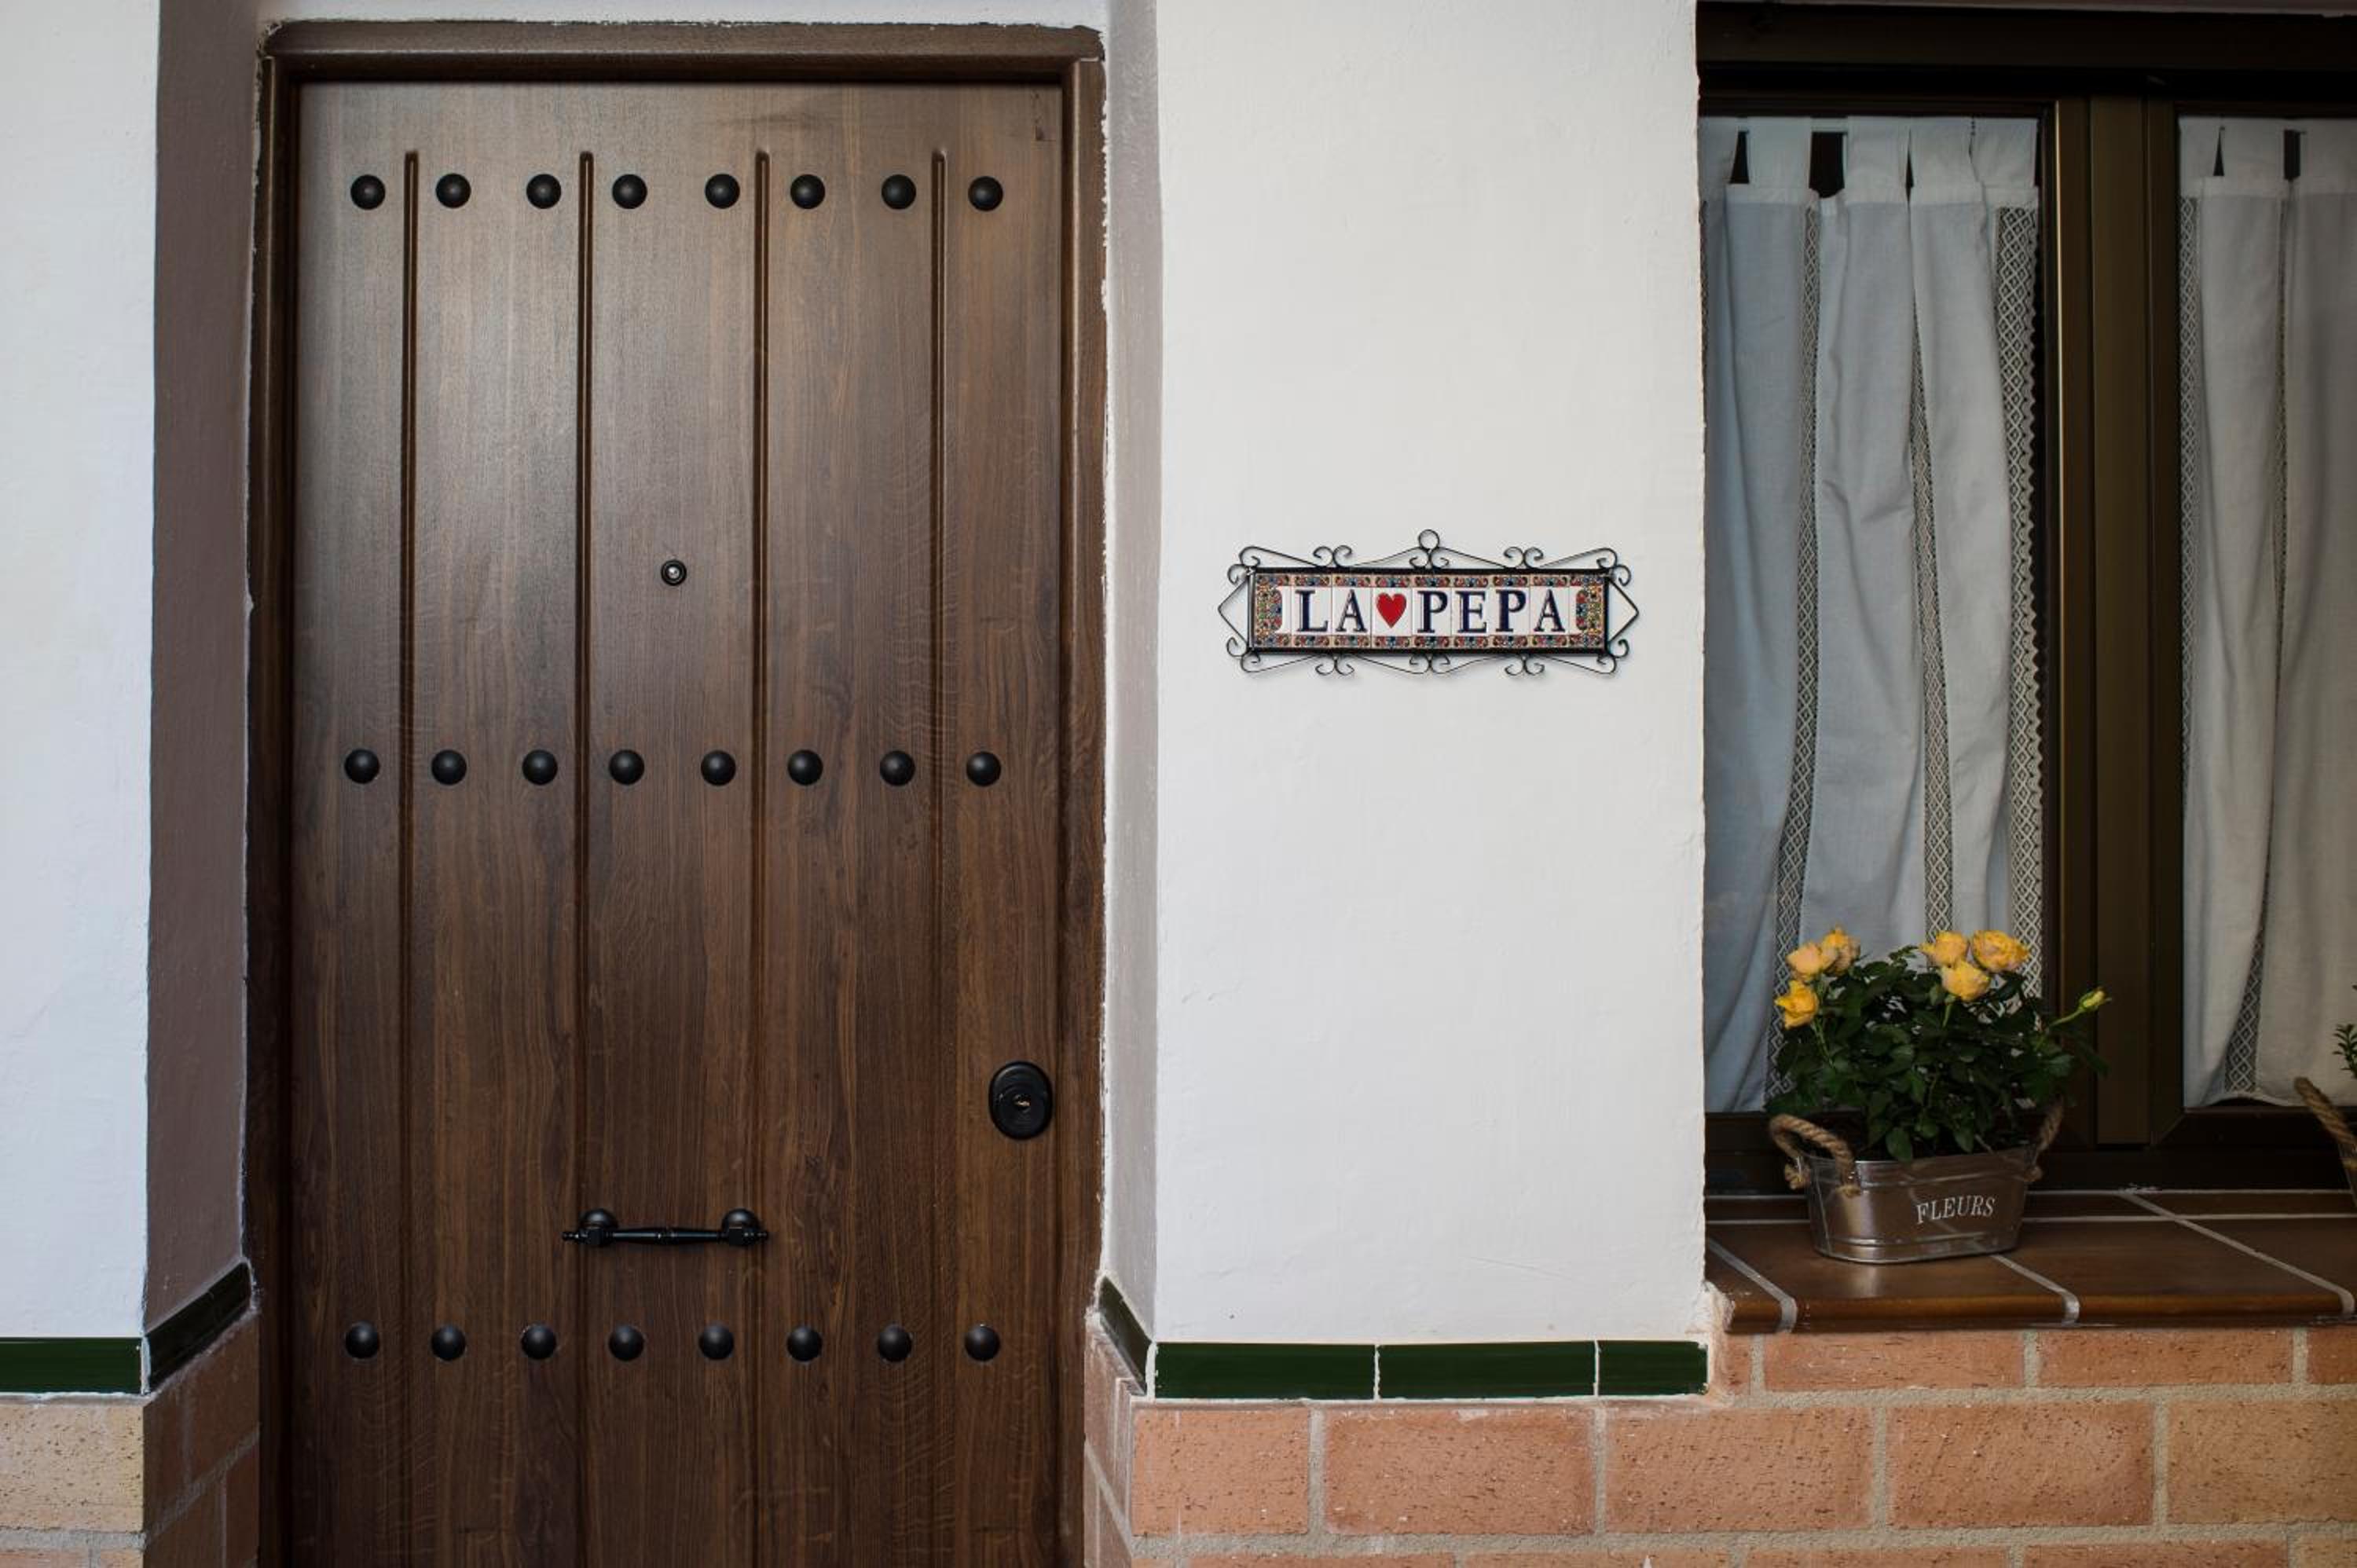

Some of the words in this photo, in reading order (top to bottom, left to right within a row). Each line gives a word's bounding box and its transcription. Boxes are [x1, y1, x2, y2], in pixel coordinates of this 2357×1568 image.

[1296, 589, 1367, 633] LA
[1417, 588, 1566, 633] PEPA
[1915, 1195, 1996, 1225] FLEURS
